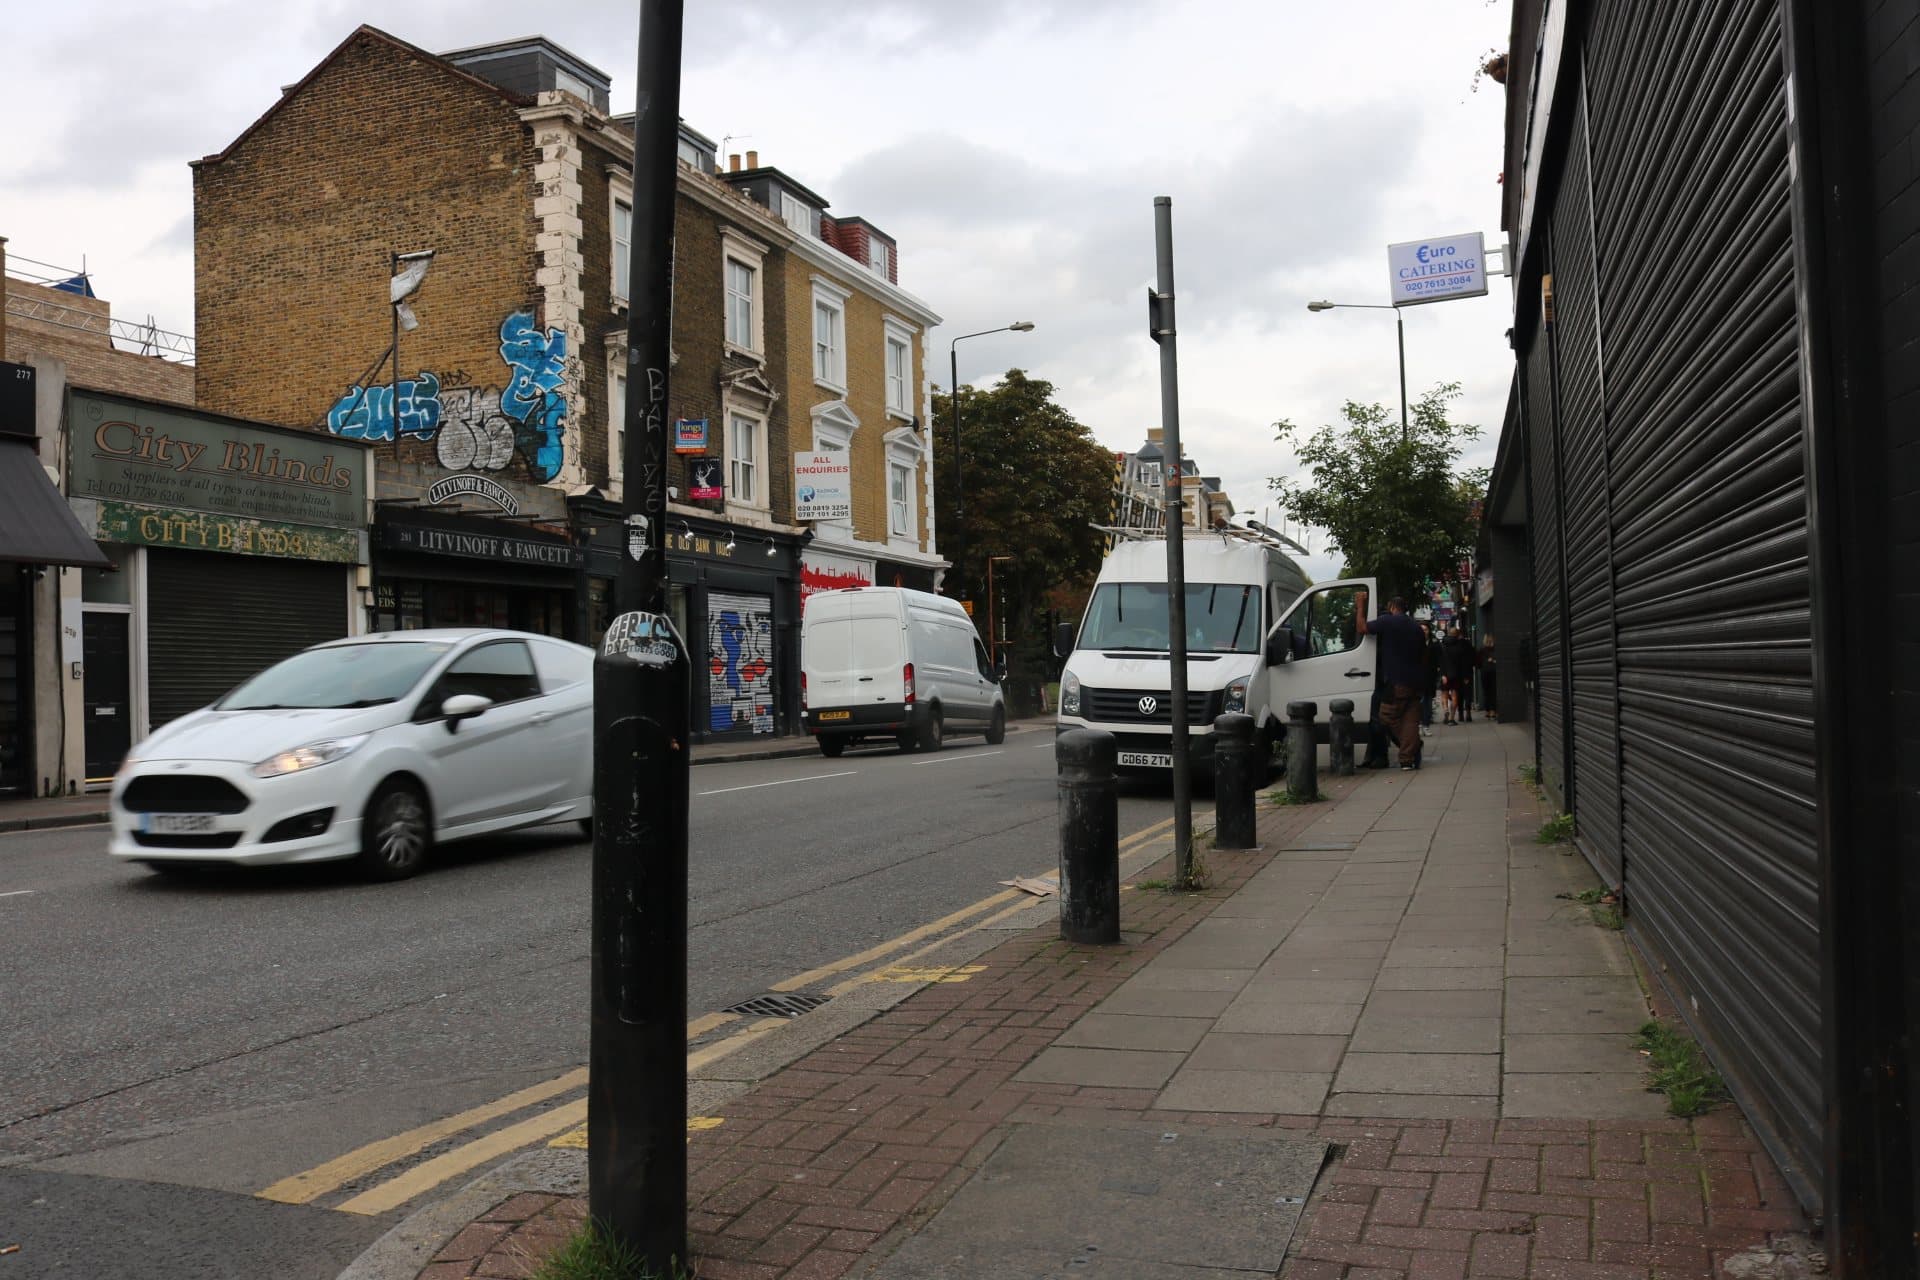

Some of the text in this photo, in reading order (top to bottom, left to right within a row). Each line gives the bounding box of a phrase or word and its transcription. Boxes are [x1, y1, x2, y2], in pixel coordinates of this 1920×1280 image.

[1399, 258, 1476, 279] CATERING
[1405, 282, 1423, 292] 020
[1424, 279, 1446, 289] 7613
[1448, 275, 1472, 286] 3084
[16, 368, 31, 381] 277
[95, 421, 352, 488] City Blinds
[813, 456, 831, 464] ALL
[796, 465, 849, 474] ENQUIRIES
[109, 483, 130, 495] 020
[121, 467, 332, 507] Suppliers of all types of window blinds
[431, 475, 476, 502] LITVINOFF
[482, 478, 518, 515] FAWCETT
[139, 514, 209, 546] CITY
[419, 529, 498, 556] LITVINOFF
[502, 542, 512, 557] &
[515, 542, 571, 565] FAWCETT
[678, 534, 690, 551] OLD
[695, 537, 711, 553] BANK
[1122, 753, 1171, 767] GD66 ZTW
